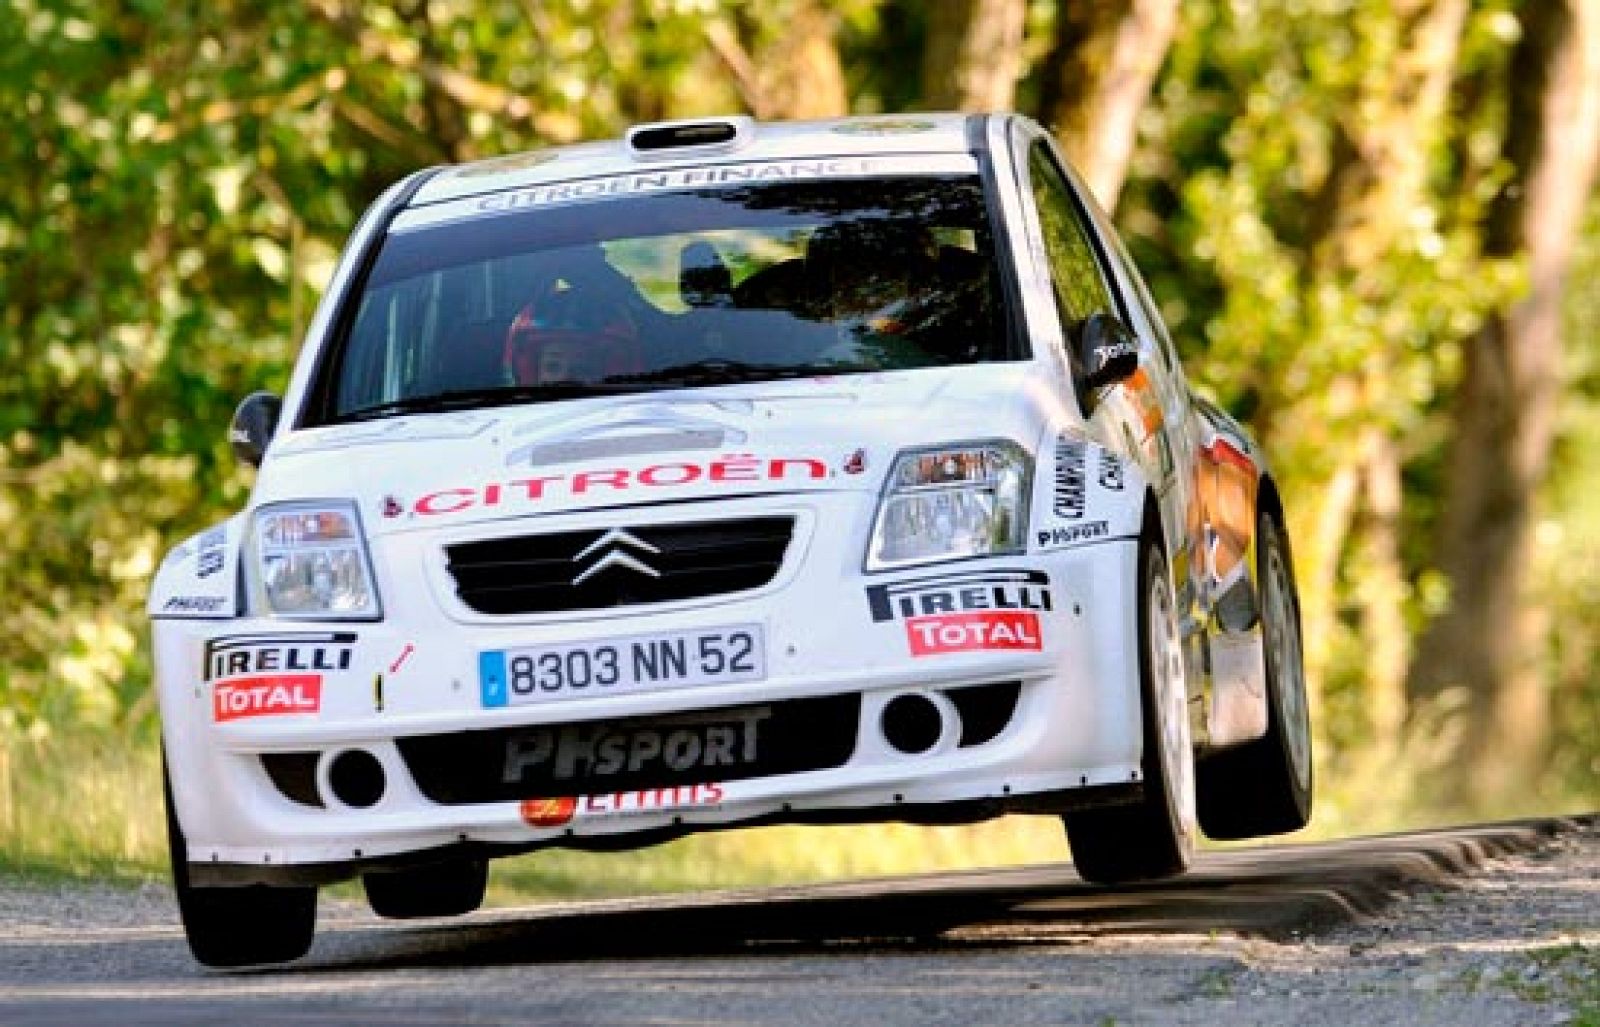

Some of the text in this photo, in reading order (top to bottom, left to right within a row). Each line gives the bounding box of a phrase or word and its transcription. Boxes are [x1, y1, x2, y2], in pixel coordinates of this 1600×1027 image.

[682, 160, 880, 186] FINANCE
[866, 569, 1051, 623] PIRELLI
[204, 632, 358, 681] PIRELLI
[912, 621, 1036, 647] TOTAL
[511, 632, 754, 695] 8303 NN 52
[216, 684, 314, 712] TOTAL
[502, 706, 770, 783] PHSPORT
